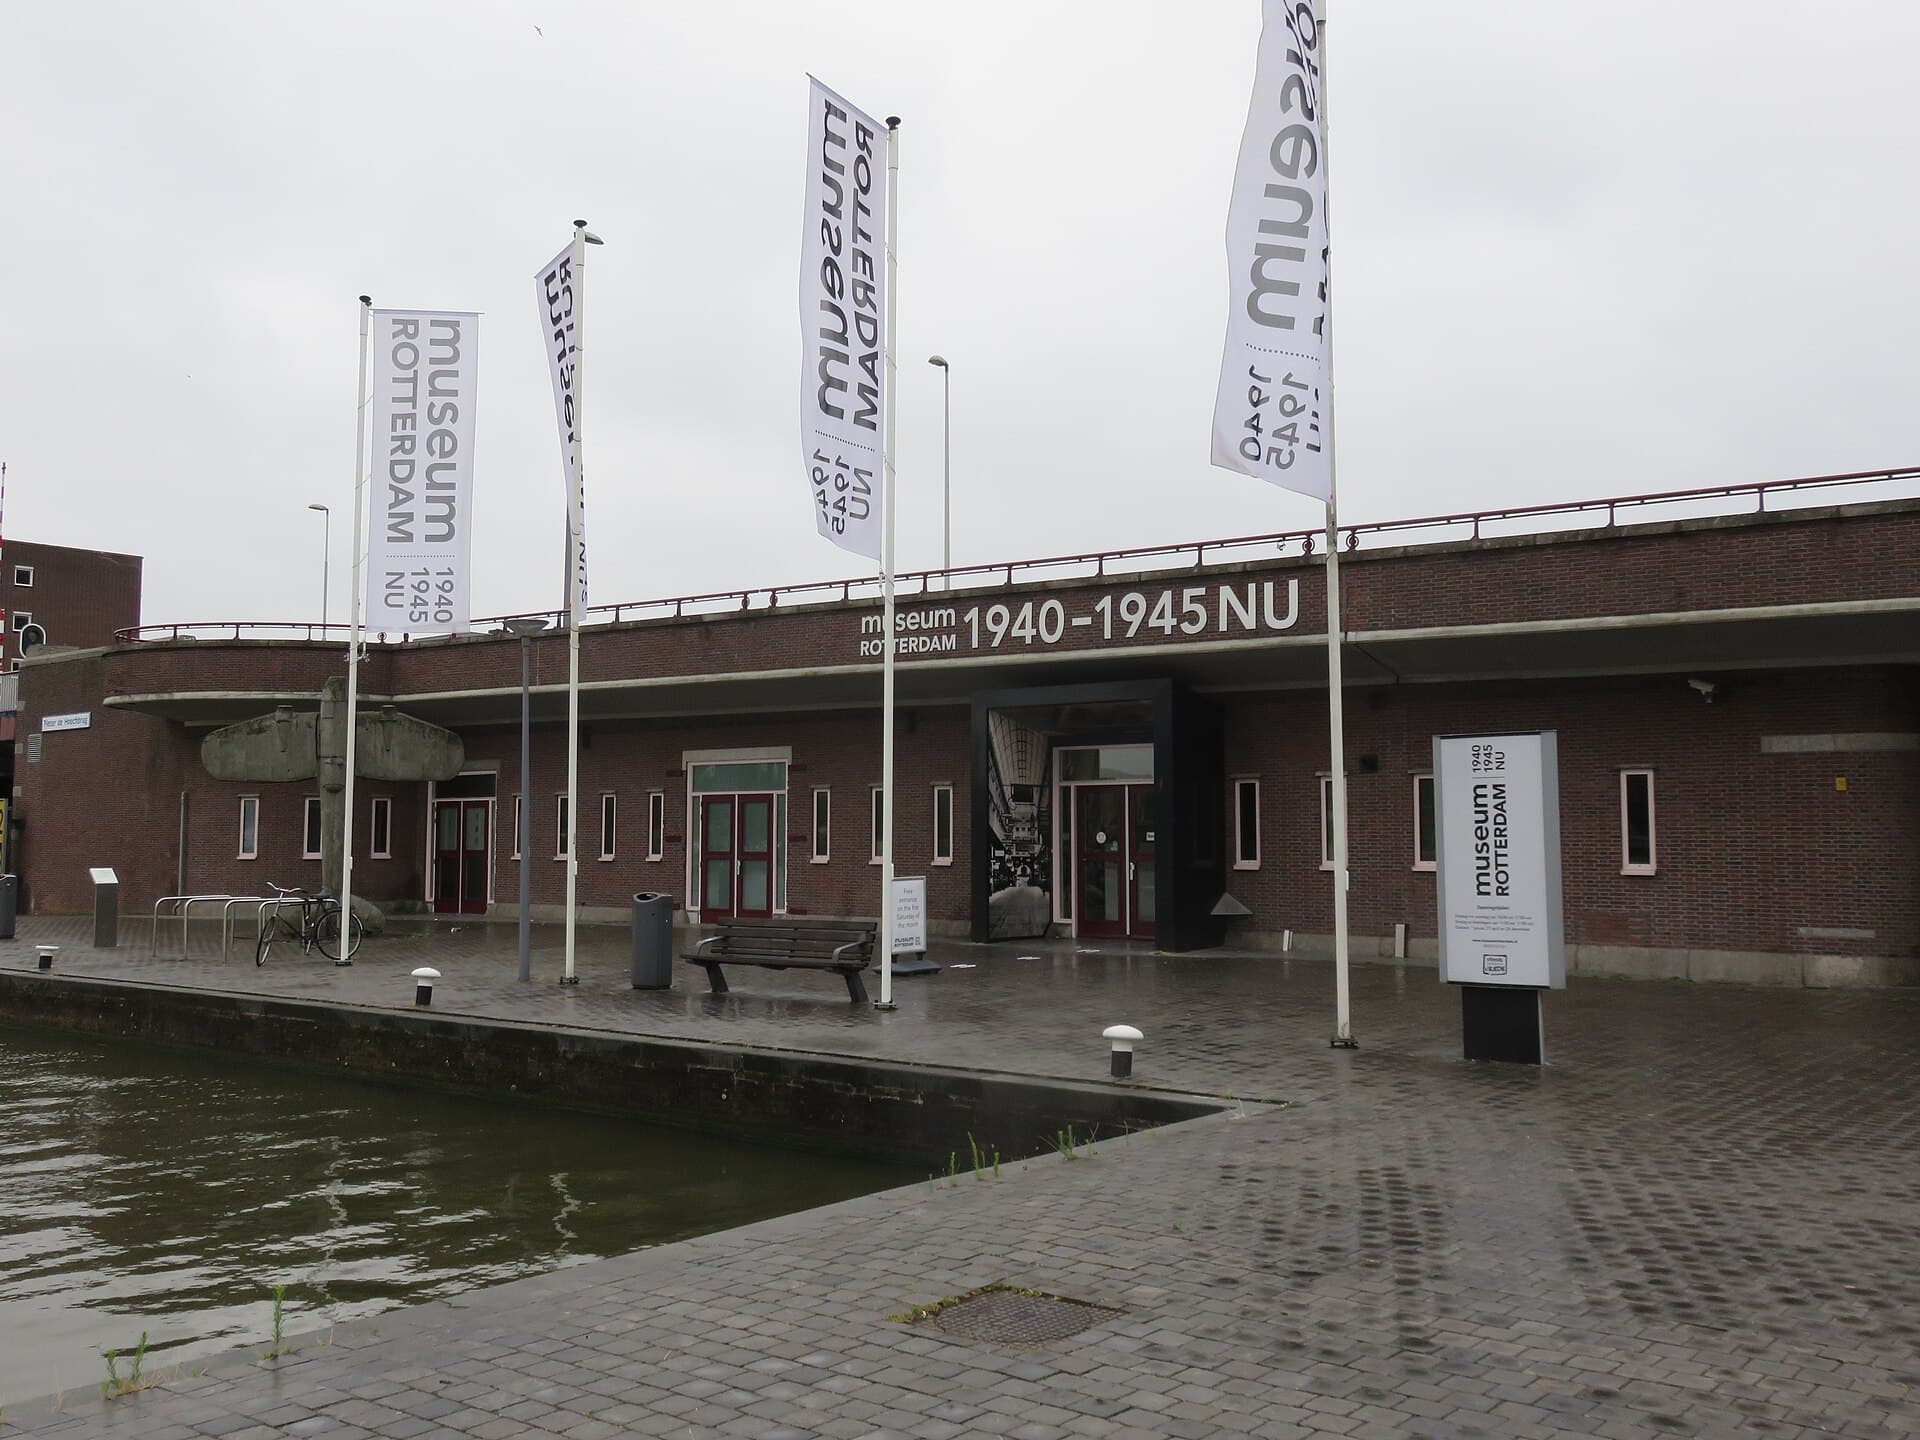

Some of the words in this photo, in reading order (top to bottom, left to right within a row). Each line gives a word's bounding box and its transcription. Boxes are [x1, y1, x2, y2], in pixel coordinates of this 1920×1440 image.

[386, 318, 420, 543] ROTTERDAM
[424, 318, 461, 543] museum
[384, 571, 405, 609] NU
[409, 567, 431, 623] 1945
[433, 567, 455, 624] 1940
[1218, 579, 1299, 632] NU
[1472, 744, 1482, 773] 1940
[1483, 744, 1494, 773] 1945
[1495, 751, 1505, 770] NU
[1473, 784, 1491, 896] museum
[1492, 783, 1510, 896] ROTTERDAM
